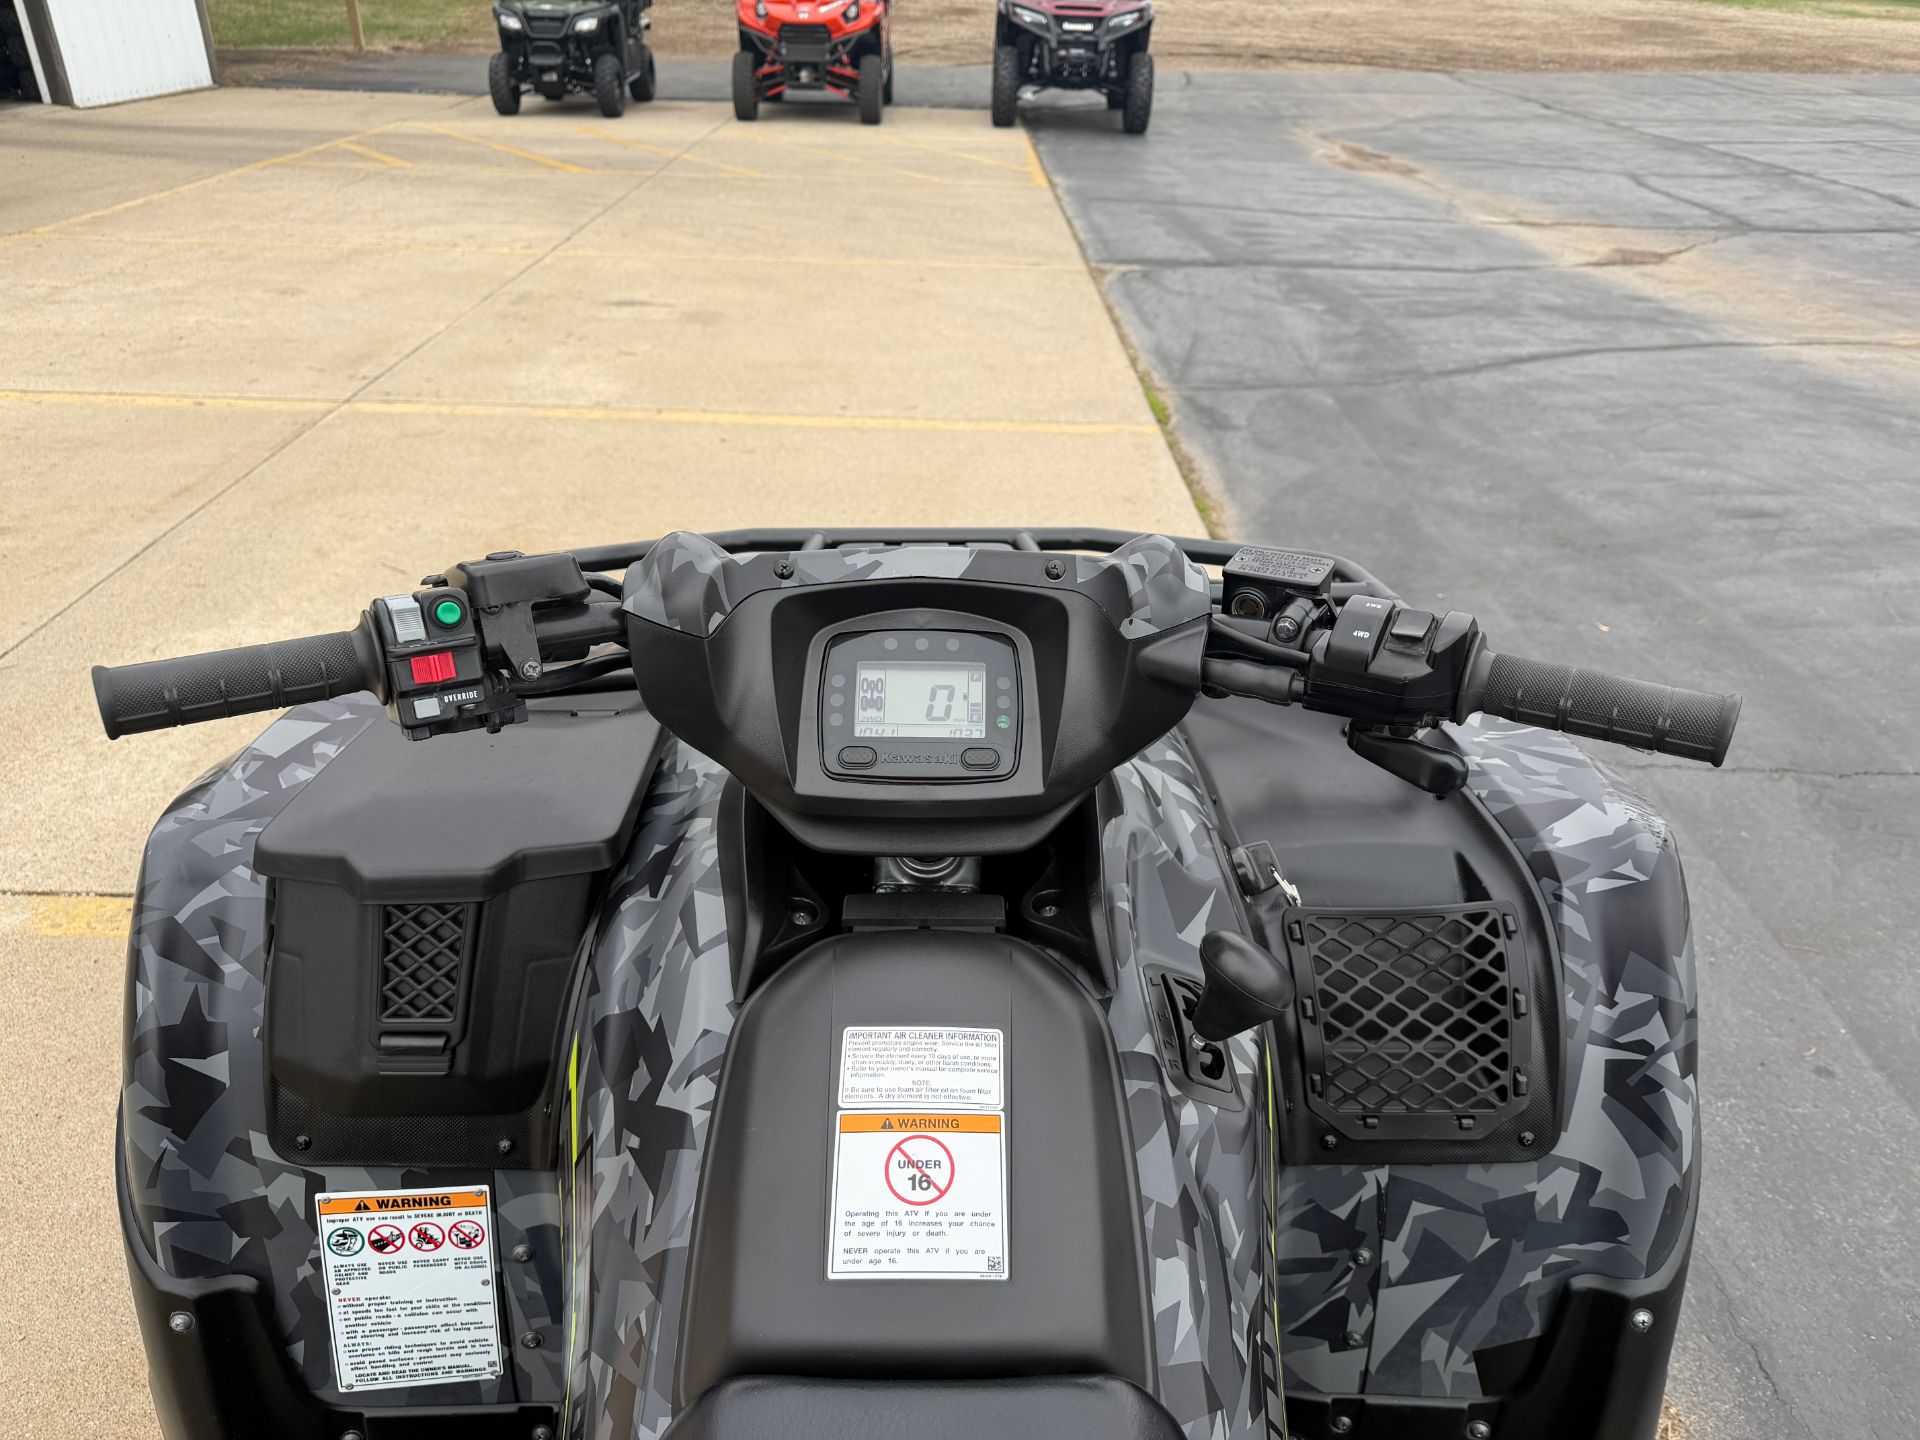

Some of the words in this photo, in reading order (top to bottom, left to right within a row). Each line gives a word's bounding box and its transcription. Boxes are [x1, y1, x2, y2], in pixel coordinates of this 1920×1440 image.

[1352, 630, 1370, 638] 4WD
[444, 690, 478, 703] OVERRIDE
[925, 684, 956, 722] 0
[880, 751, 958, 765] Kawasaki
[849, 1032, 892, 1040] IMPORTANT
[894, 1032, 907, 1040] AIR
[908, 1032, 944, 1040] CLEANER
[946, 1032, 997, 1042] INFORMATION
[898, 1118, 960, 1129] WARNING
[898, 1160, 942, 1170] UNDER
[907, 1174, 932, 1192] 16
[376, 1196, 452, 1209] WARNING
[845, 1210, 880, 1218] Operating
[886, 1230, 907, 1238] injury
[842, 1257, 863, 1265] under
[868, 1258, 882, 1266] age
